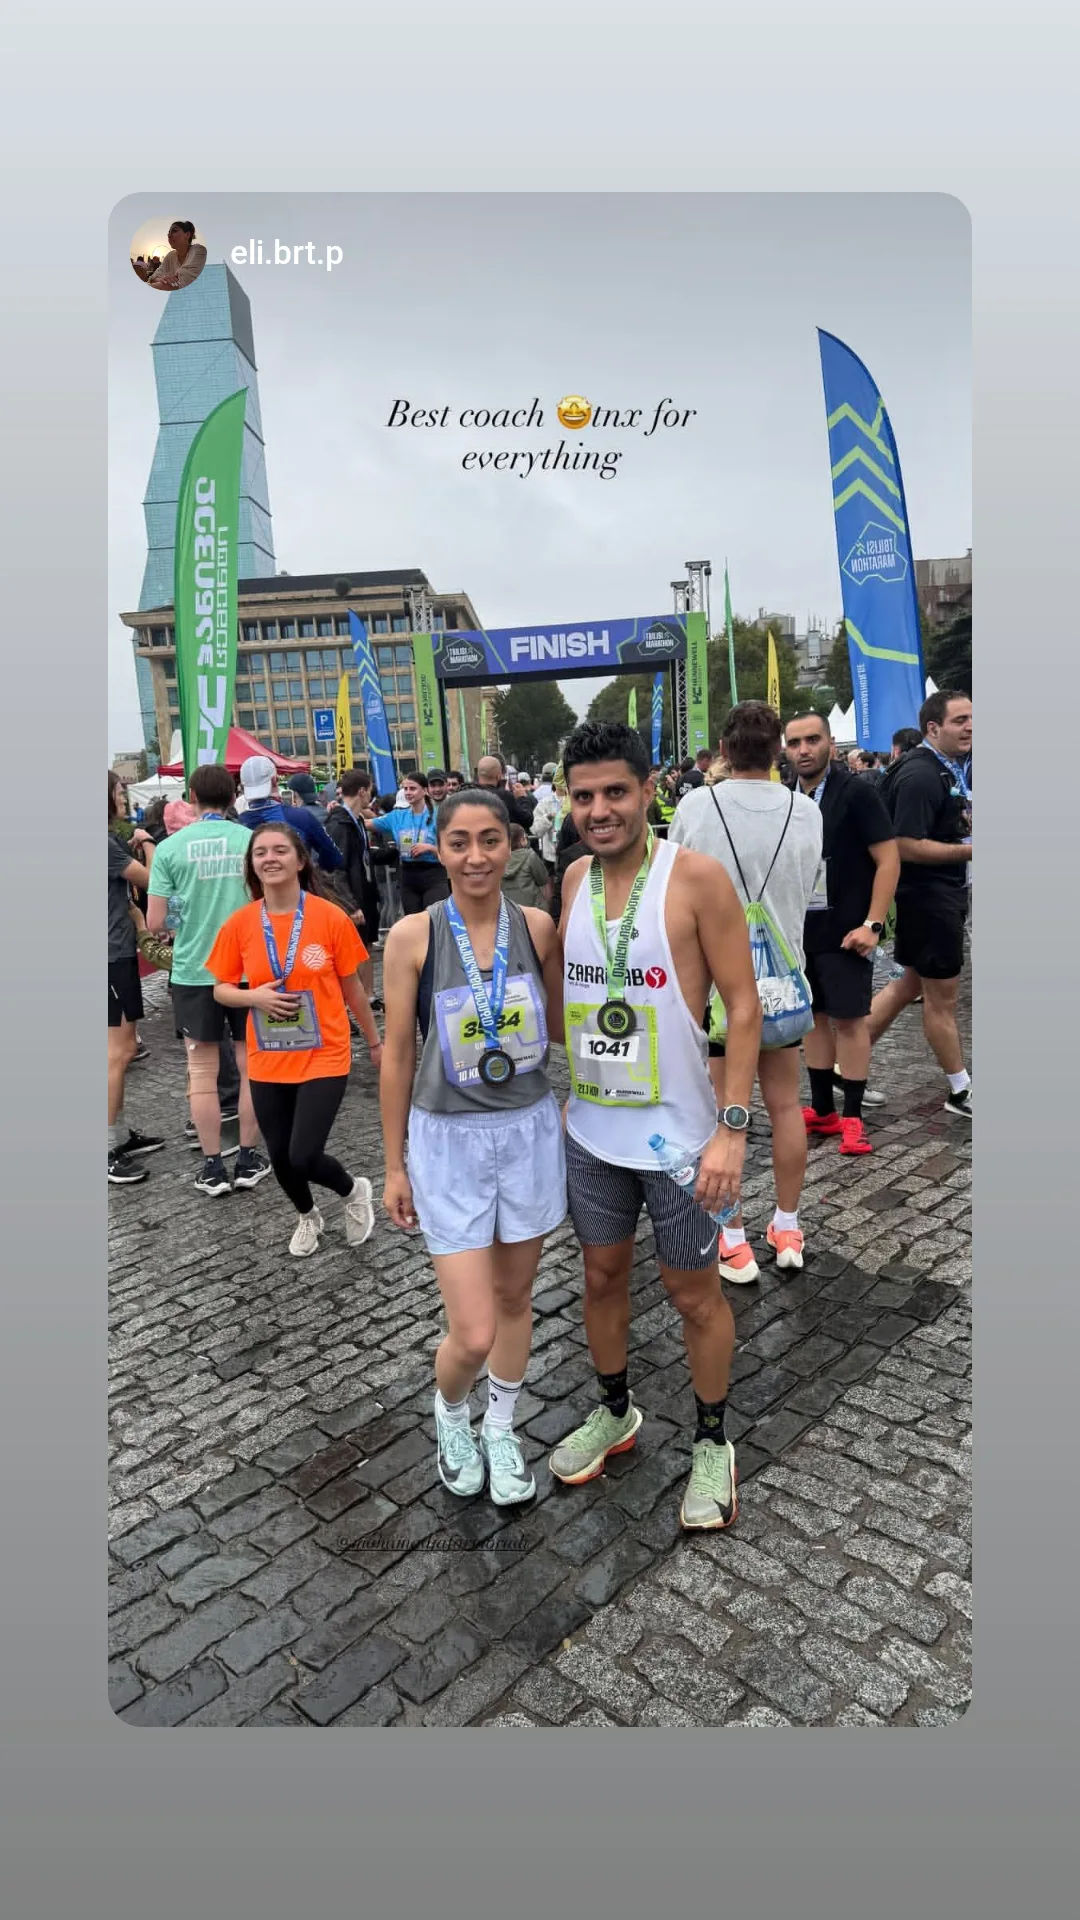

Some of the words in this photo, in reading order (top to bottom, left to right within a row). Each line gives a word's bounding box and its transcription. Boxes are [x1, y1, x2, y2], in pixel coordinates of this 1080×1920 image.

[510, 629, 610, 662] FINISH
[645, 640, 674, 648] MARATHON
[320, 715, 328, 725] P
[588, 1040, 630, 1057] 1041
[458, 1070, 467, 1082] 10
